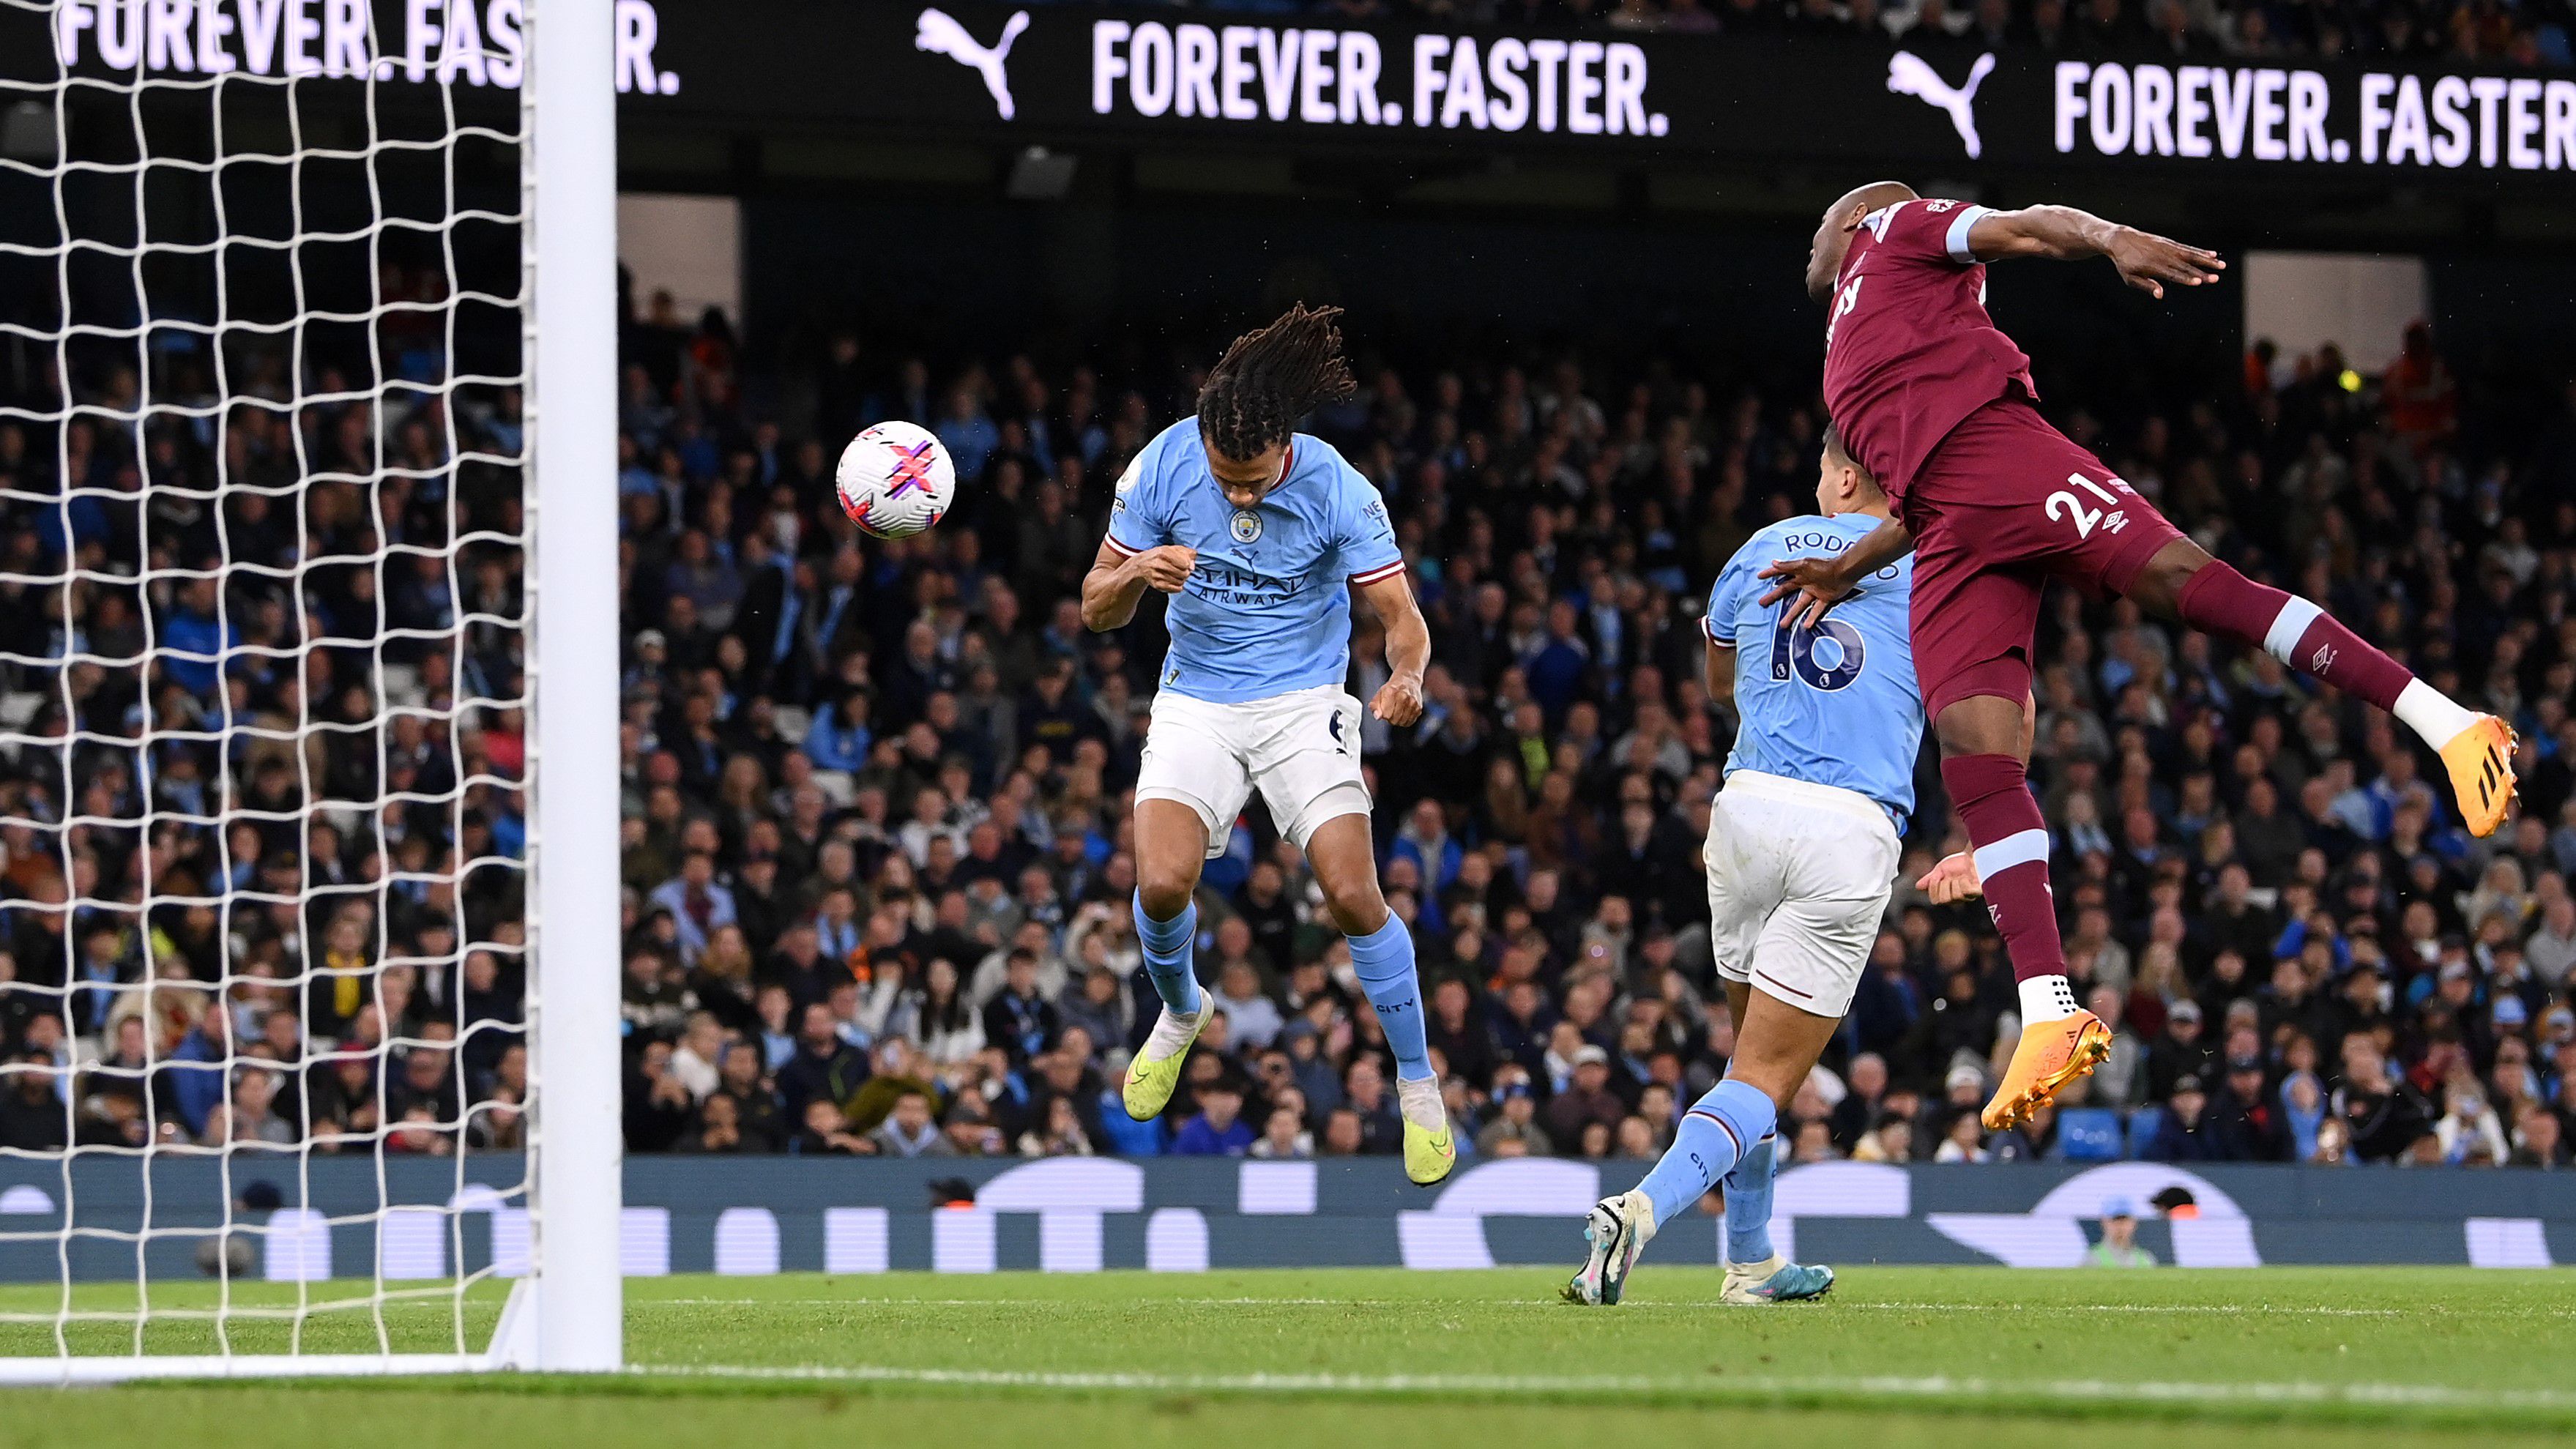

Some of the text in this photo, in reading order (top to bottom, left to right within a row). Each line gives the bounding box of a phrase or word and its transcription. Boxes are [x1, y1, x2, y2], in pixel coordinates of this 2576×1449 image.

[57, 0, 395, 82] FOREVER.
[1092, 21, 1667, 136] FOREVER. FASTER.
[2055, 62, 2349, 162] FOREVER.
[2045, 472, 2118, 540] 21
[1198, 587, 1278, 606] AIRWAY
[1784, 532, 1899, 580] RODO
[1771, 574, 1866, 691] 16
